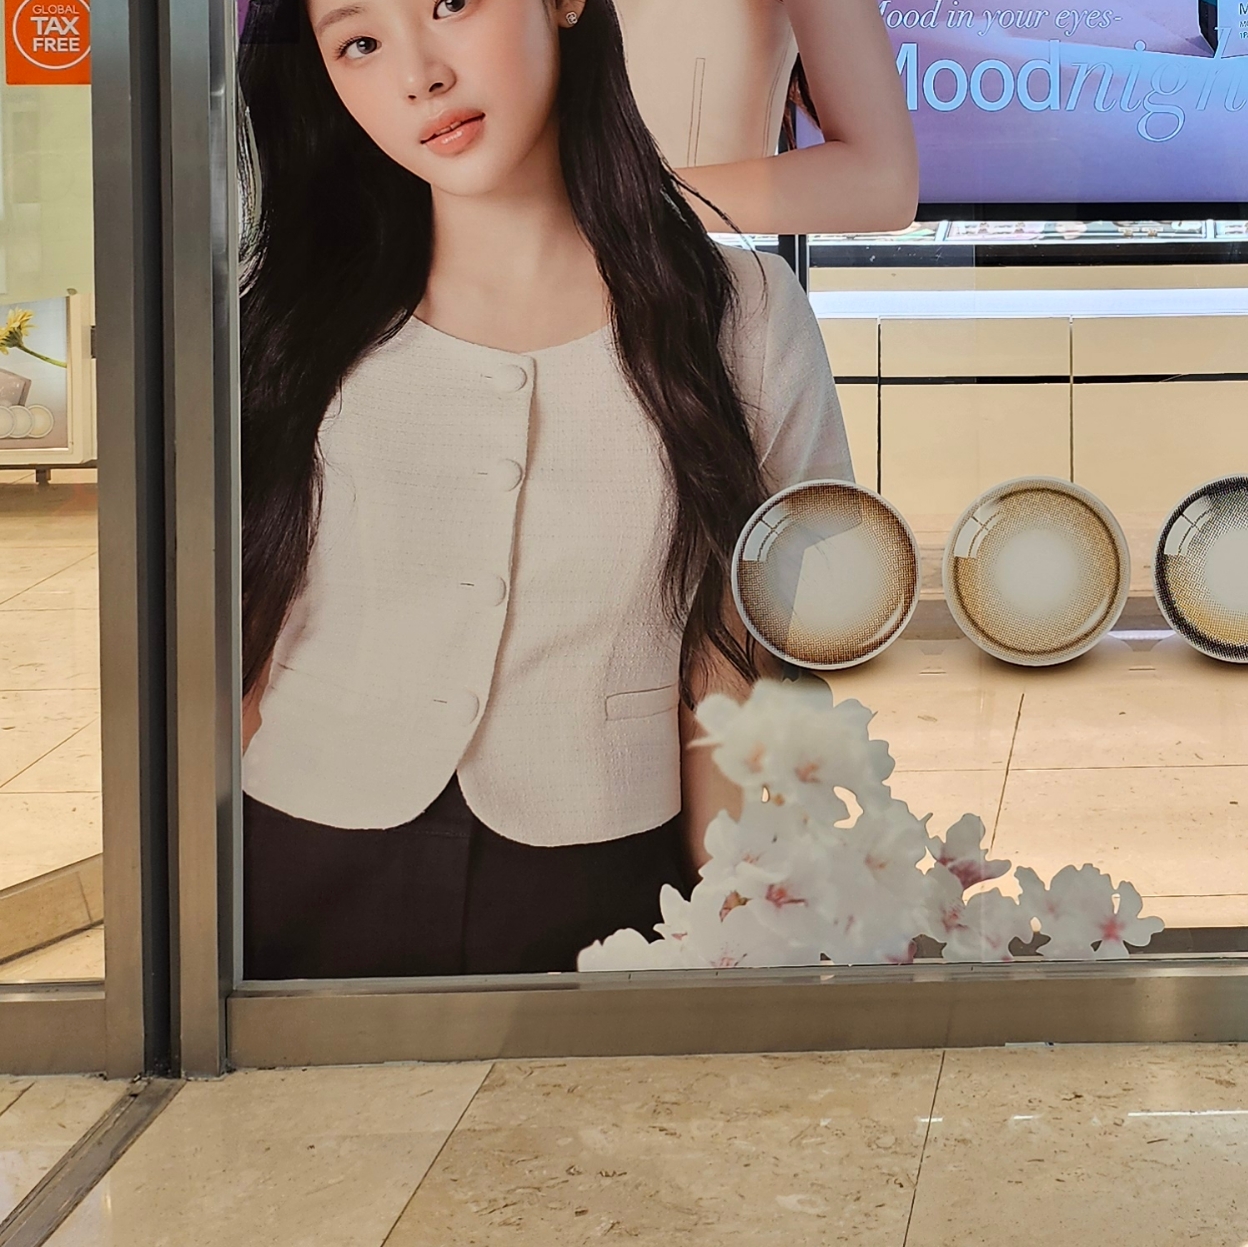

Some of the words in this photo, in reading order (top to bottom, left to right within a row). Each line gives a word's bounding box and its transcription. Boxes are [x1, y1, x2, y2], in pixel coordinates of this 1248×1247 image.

[32, 4, 80, 15] GLOBAL
[946, 0, 974, 28] in
[977, 8, 1049, 36] your
[1055, 6, 1122, 36] eyes-
[30, 16, 80, 36] TAX
[33, 37, 80, 52] FREE
